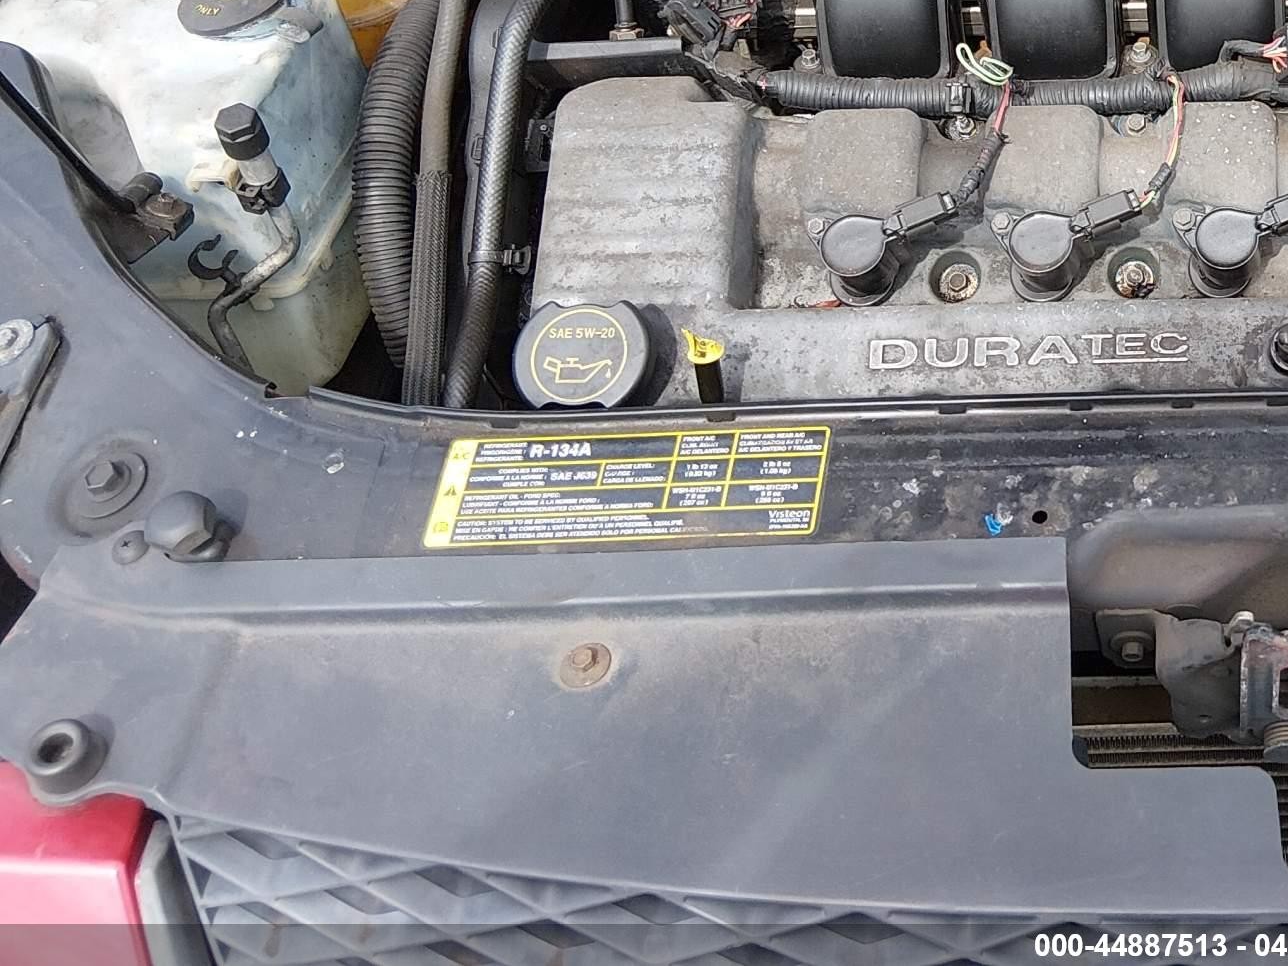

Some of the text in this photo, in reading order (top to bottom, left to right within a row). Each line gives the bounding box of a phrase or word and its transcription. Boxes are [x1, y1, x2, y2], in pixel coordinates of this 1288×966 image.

[195, 3, 222, 15] ONLY
[549, 327, 616, 339] SAE 5W-20
[868, 332, 1189, 370] DURATEC
[529, 441, 592, 458] R-134A
[550, 472, 572, 481] SAE
[768, 509, 811, 519] Visteon
